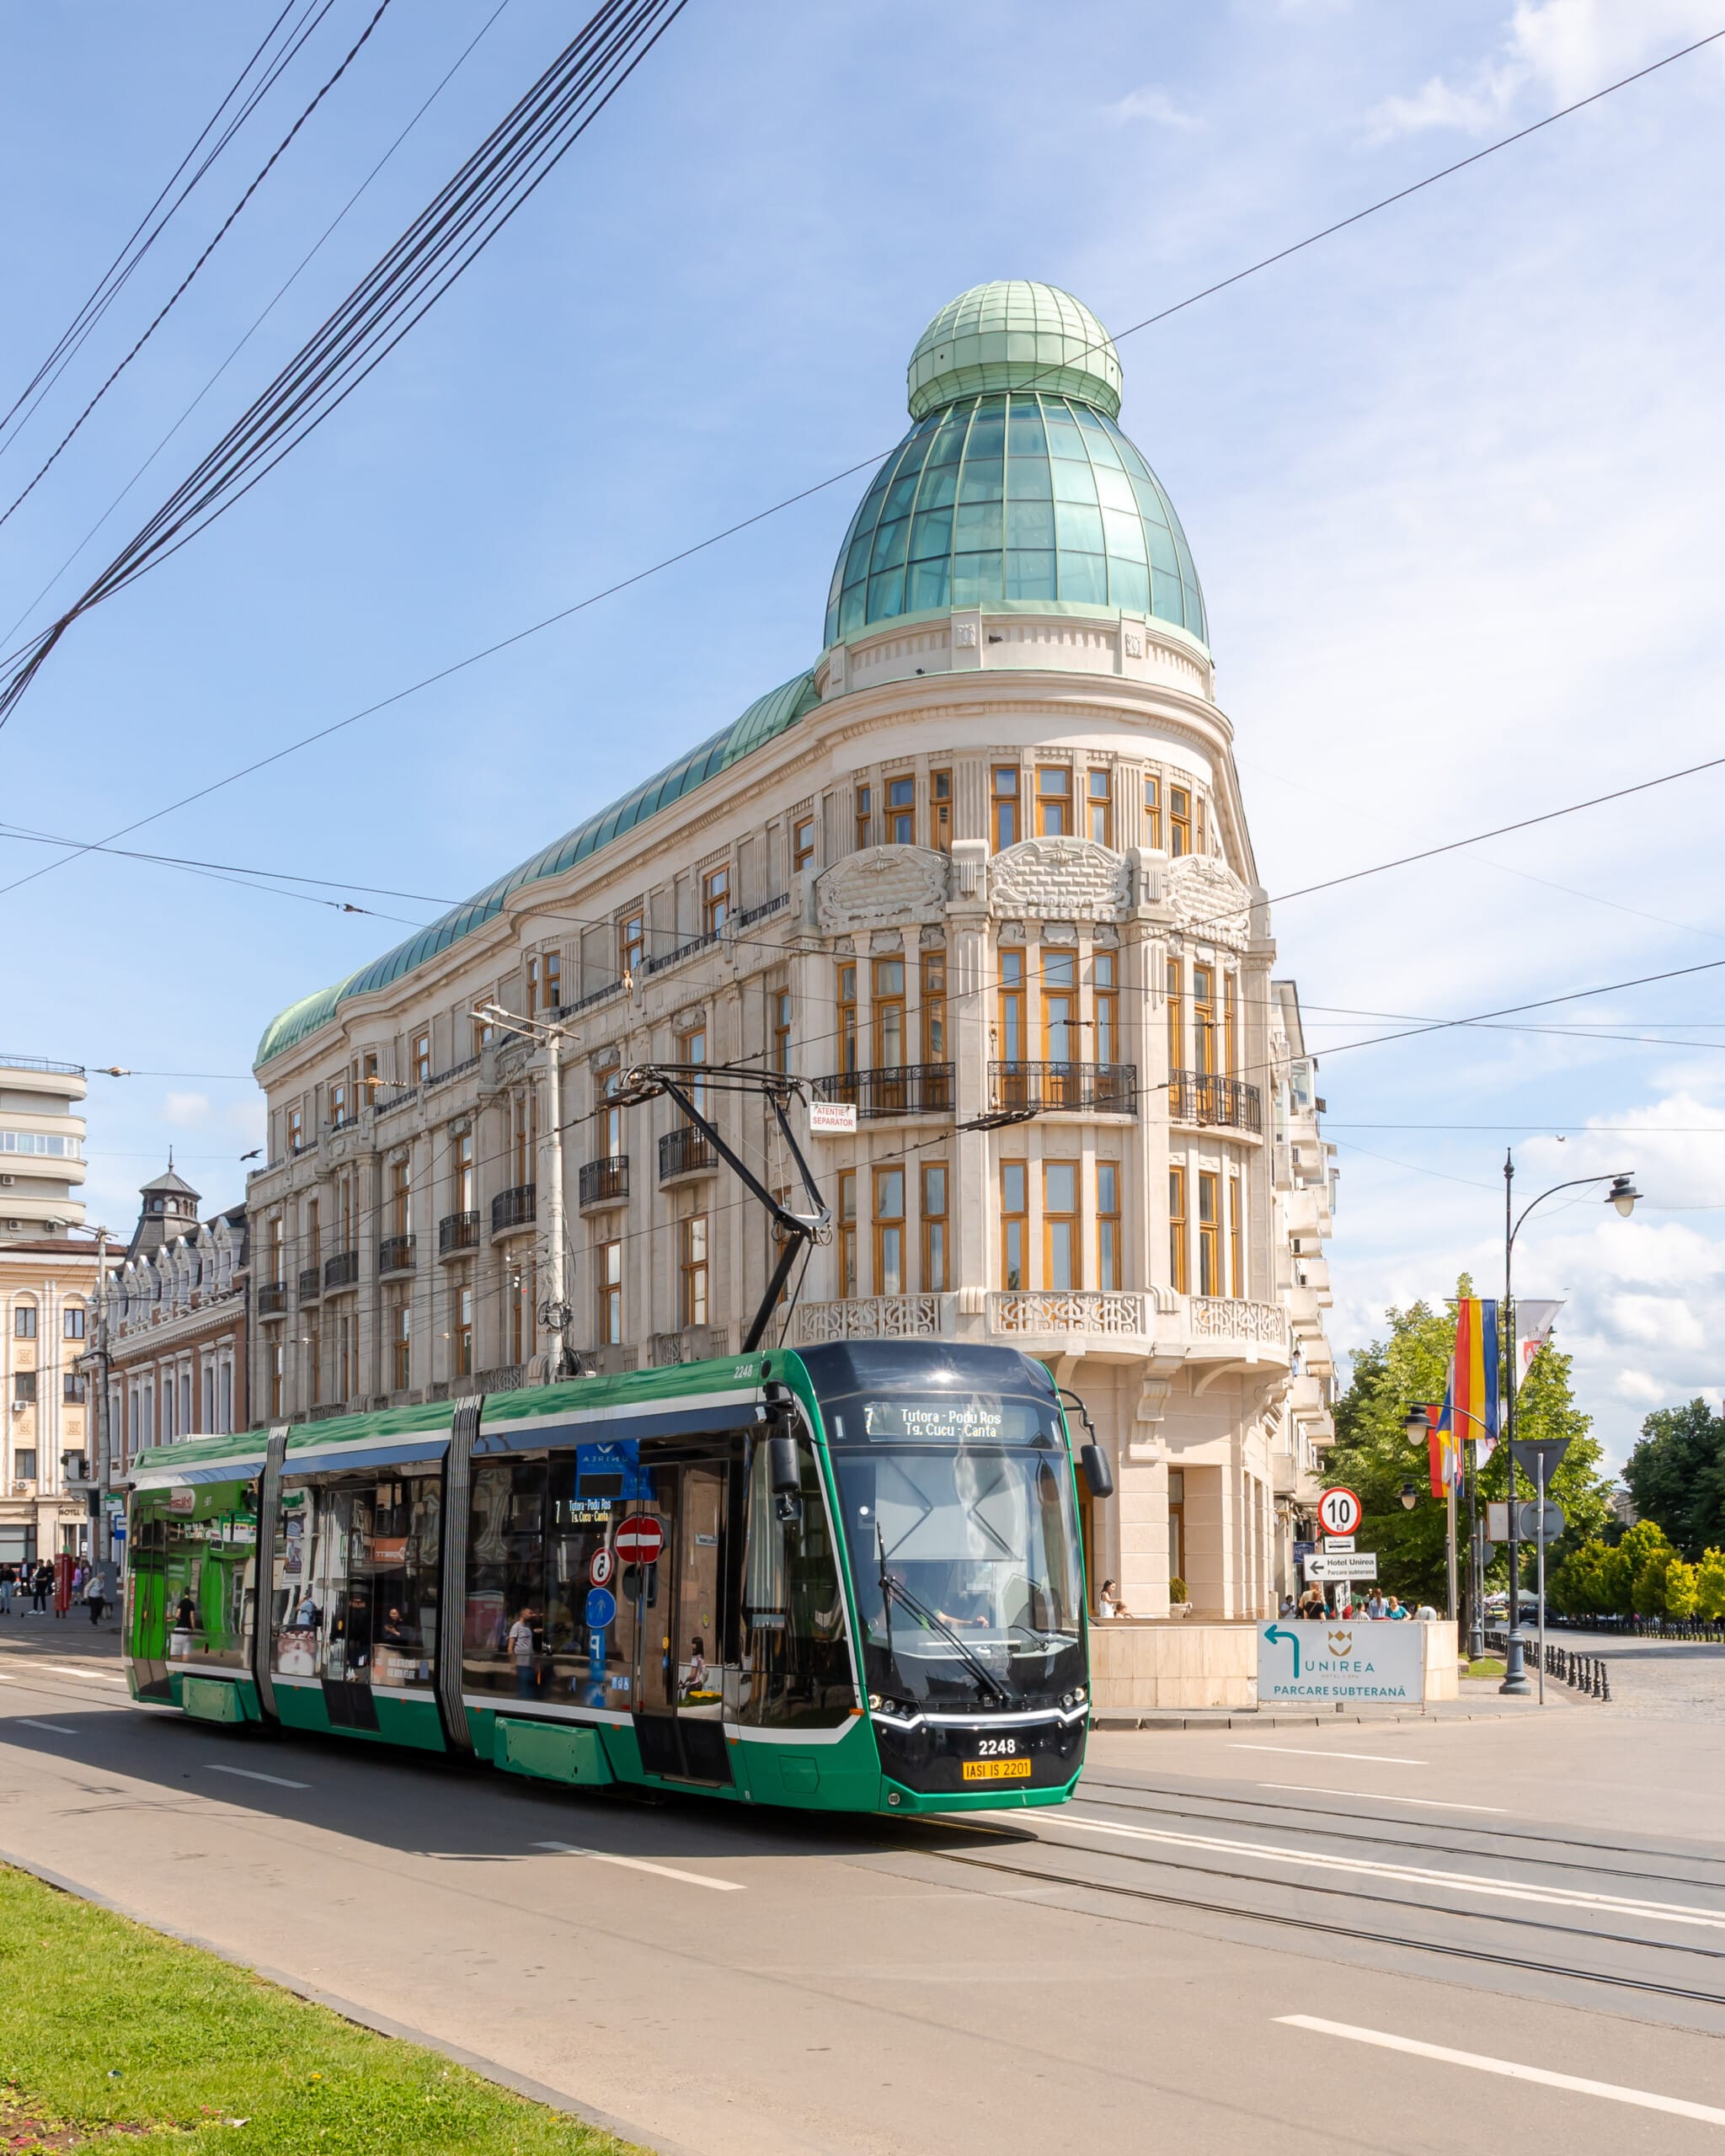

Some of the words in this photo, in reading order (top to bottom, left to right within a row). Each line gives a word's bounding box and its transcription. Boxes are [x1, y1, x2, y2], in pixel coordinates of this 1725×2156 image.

[813, 1116, 853, 1127] SEPARATOR
[734, 1364, 753, 1379] 2248
[864, 1407, 873, 1434] 7
[901, 1409, 940, 1422] Tutora
[948, 1411, 978, 1424] Podu
[980, 1412, 1001, 1425] Ros
[926, 1422, 955, 1436] Cucu
[964, 1424, 997, 1437] Canta
[1327, 1498, 1350, 1524] 10
[1306, 1661, 1375, 1673] UNIREA
[1274, 1685, 1329, 1695] PARCARE
[1332, 1685, 1406, 1697] SUBTERANĂ
[979, 1738, 1016, 1755] 2248
[966, 1764, 985, 1778] IASI
[990, 1764, 1000, 1776] IS
[1003, 1762, 1028, 1776] 2201
